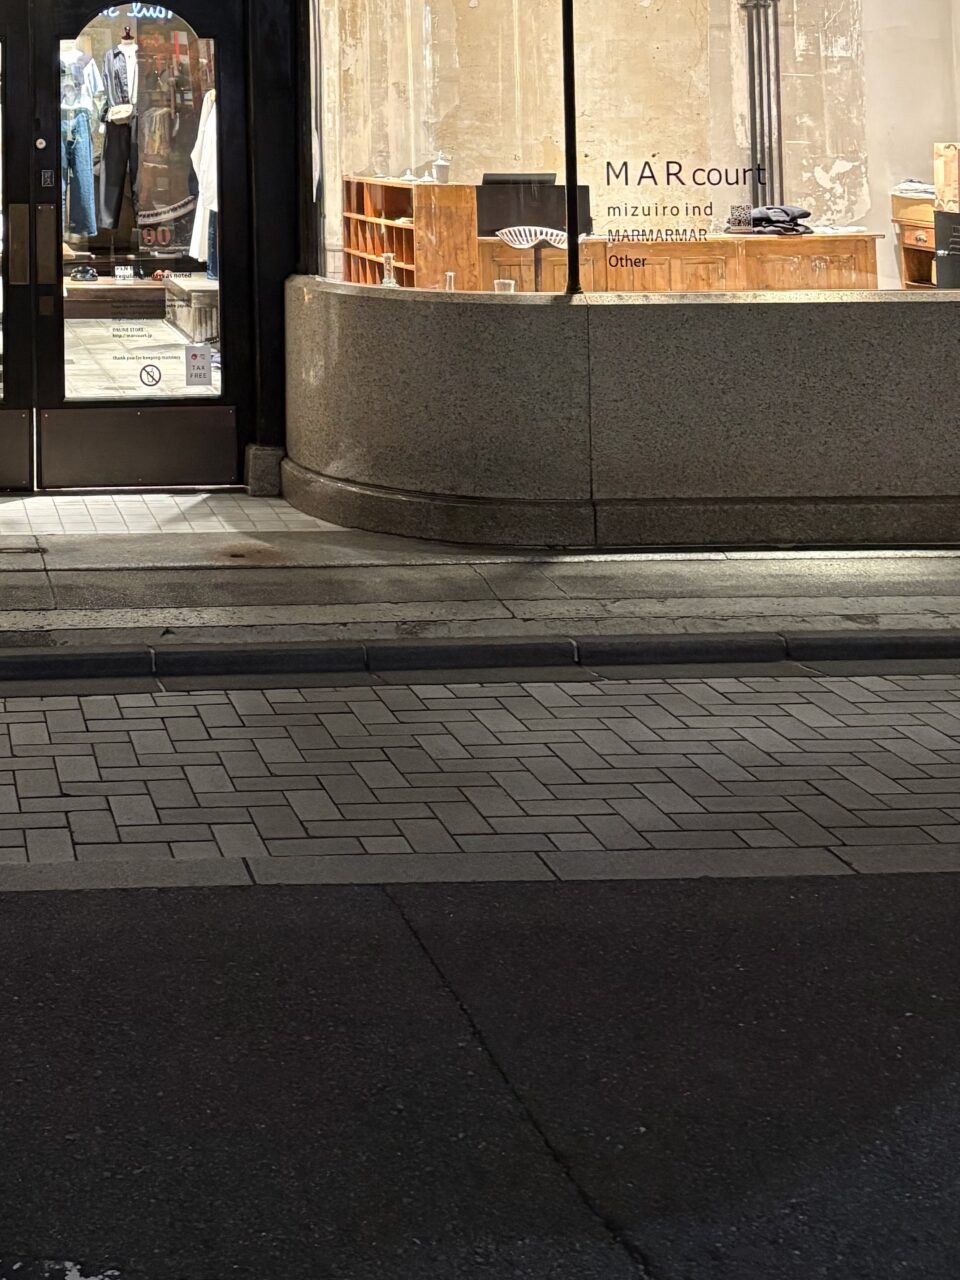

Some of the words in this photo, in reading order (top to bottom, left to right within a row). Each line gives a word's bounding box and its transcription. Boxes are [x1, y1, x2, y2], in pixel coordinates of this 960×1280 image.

[607, 203, 680, 217] mizuiro
[685, 202, 713, 217] ind
[607, 229, 708, 242] MARMARMAR
[608, 255, 647, 268] Other
